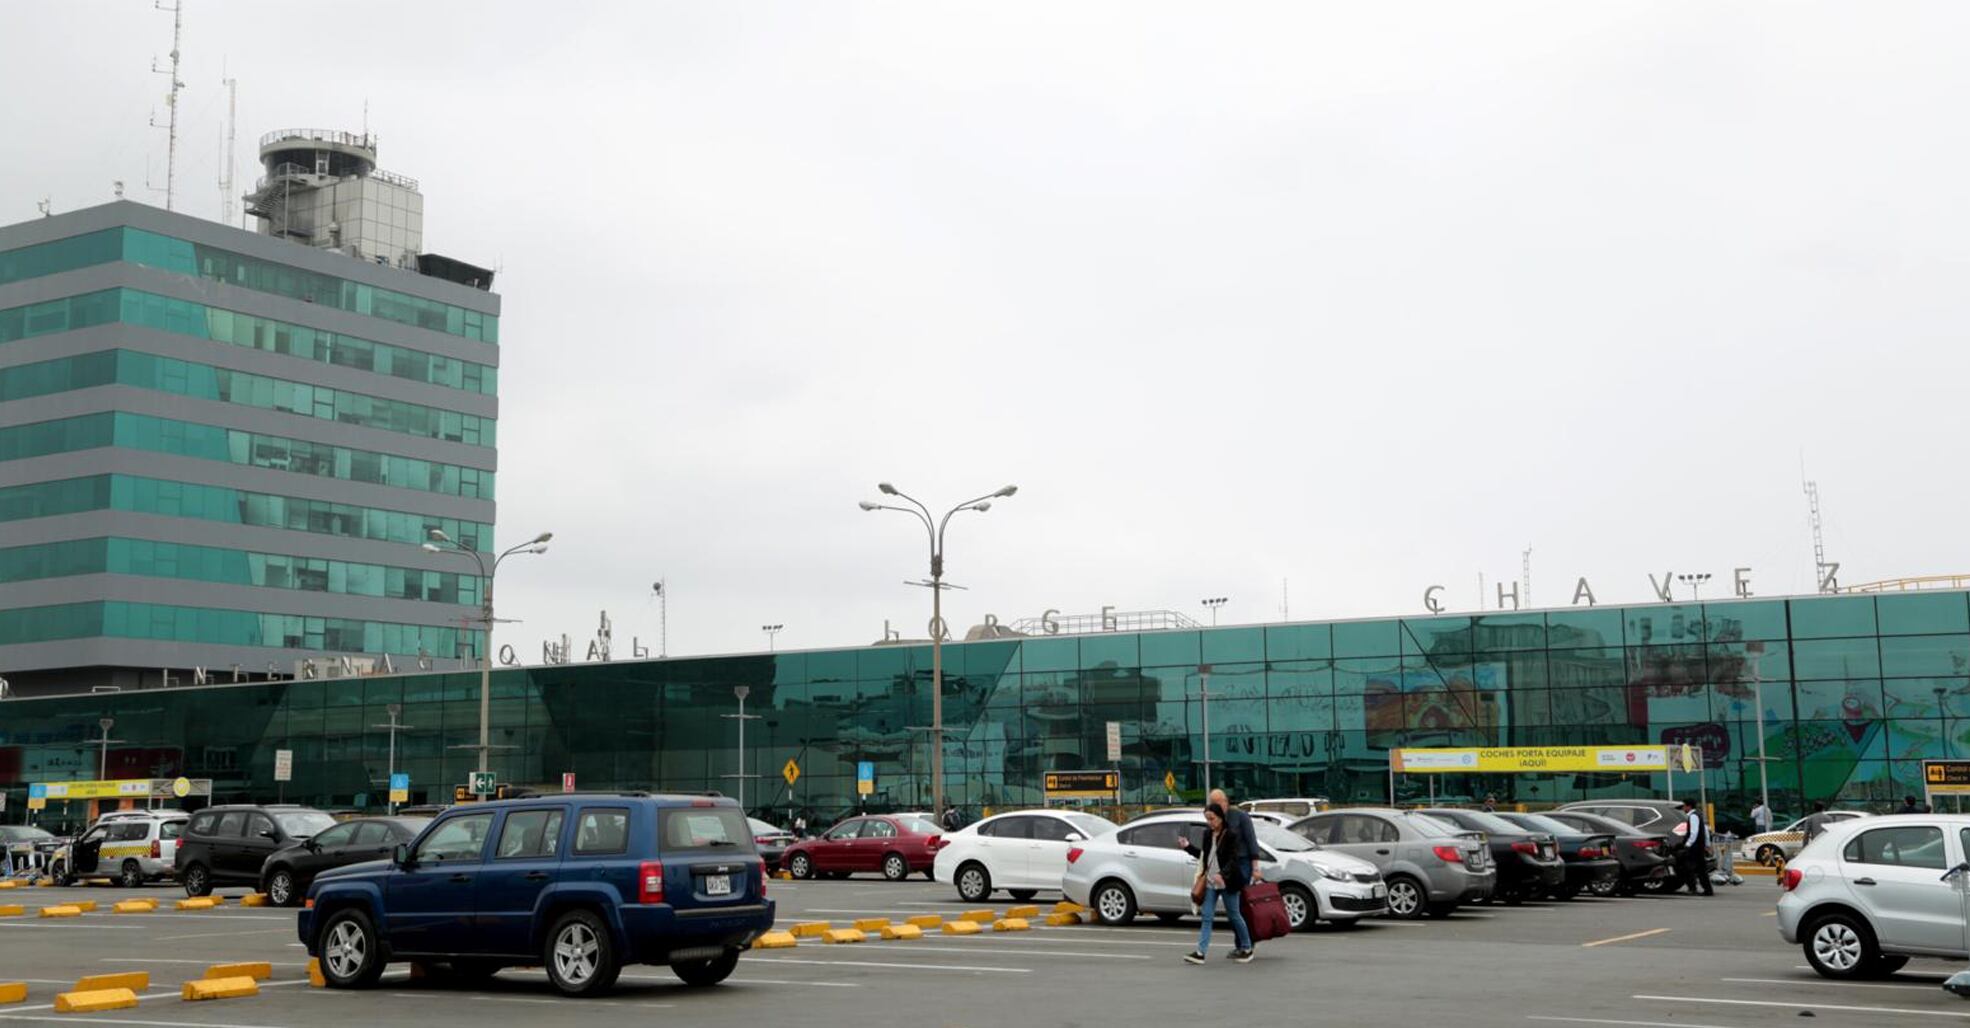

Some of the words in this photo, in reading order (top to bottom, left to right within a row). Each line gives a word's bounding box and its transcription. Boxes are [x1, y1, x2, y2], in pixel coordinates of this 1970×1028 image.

[1424, 562, 1840, 613] CHAVEZ
[1480, 750, 1515, 759] COCHES
[1517, 749, 1544, 758] PORTA
[1546, 748, 1586, 758] EQUIPAJE
